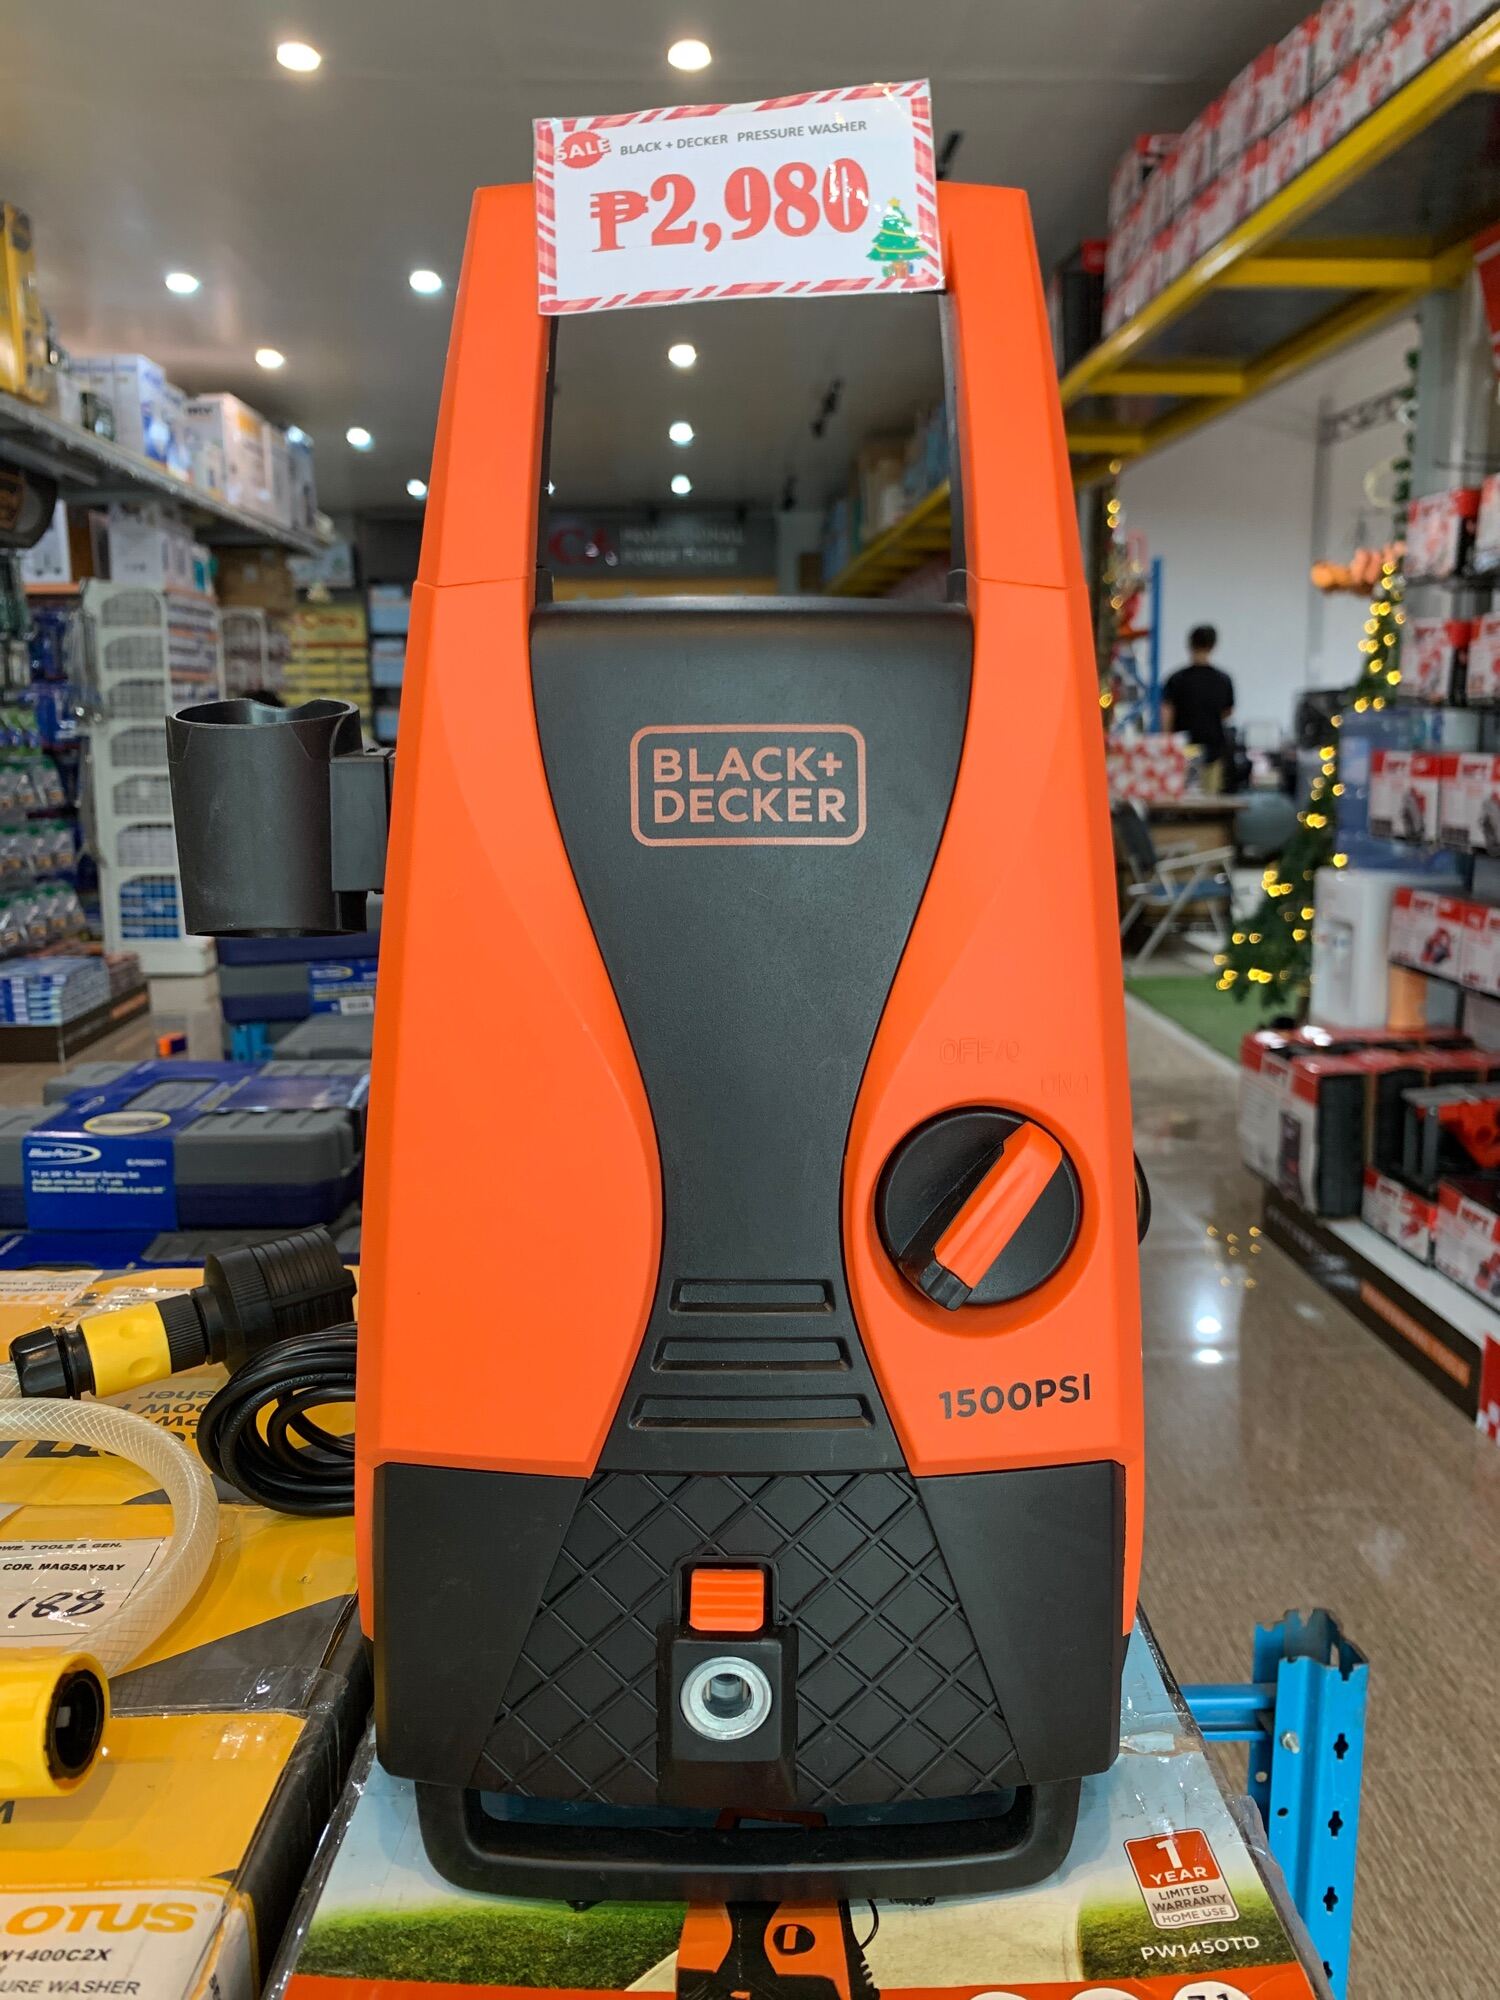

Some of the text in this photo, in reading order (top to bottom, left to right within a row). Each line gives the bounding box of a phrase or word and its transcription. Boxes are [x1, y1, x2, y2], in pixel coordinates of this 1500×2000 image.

[554, 138, 612, 161] SALE
[619, 120, 867, 156] BLACK + DECKER PRESSURE WASHER
[653, 746, 843, 783] BLACK+
[653, 787, 847, 824] DECKER
[938, 1373, 1091, 1420] 1500PSI
[2, 1563, 126, 1571] COR. MAGSAYSAY
[1156, 1839, 1183, 1869] 1
[1149, 1866, 1208, 1885] YEAR
[1152, 1894, 1227, 1913] WARRANTY
[1158, 1884, 1209, 1901] LIMITED
[3, 1902, 198, 1936] OTUS
[1161, 1907, 1228, 1924] HOME USE
[1140, 1936, 1260, 1960] PW1450TD
[48, 1980, 141, 1996] WASHER
